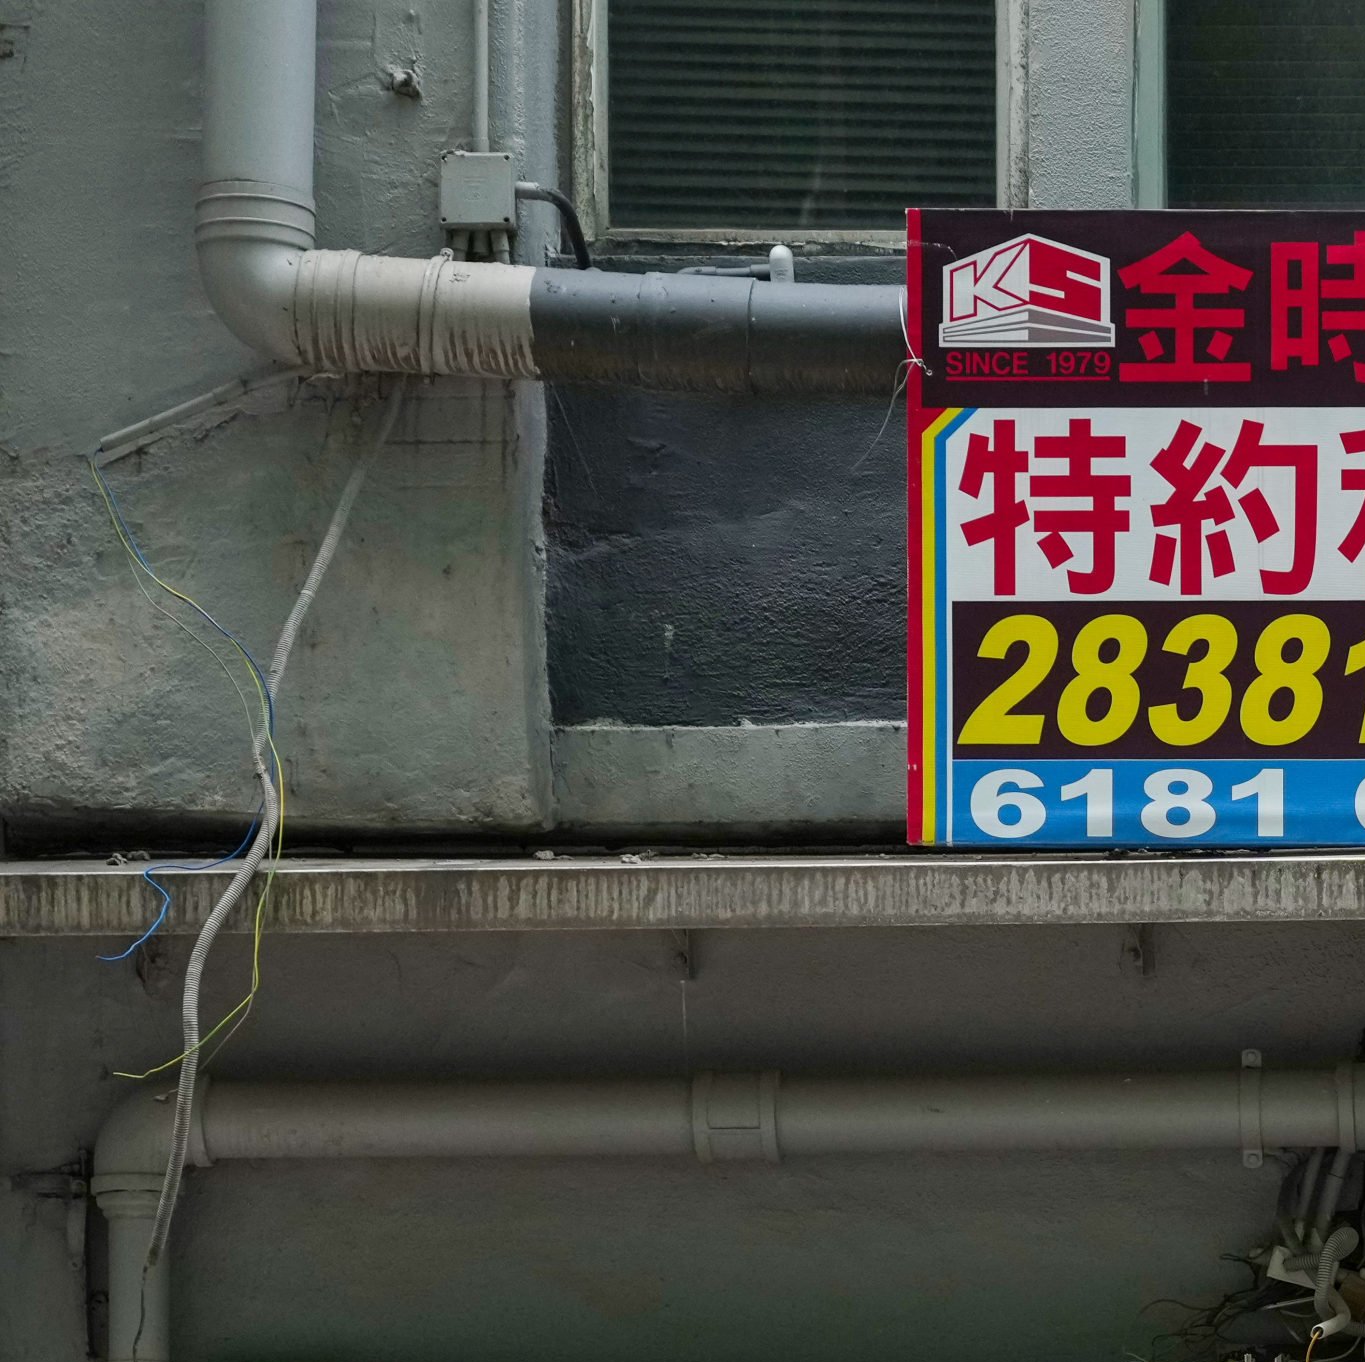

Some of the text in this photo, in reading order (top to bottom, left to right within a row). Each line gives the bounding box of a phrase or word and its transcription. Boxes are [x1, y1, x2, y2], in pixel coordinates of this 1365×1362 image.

[950, 236, 1108, 325] KS
[945, 352, 1111, 375] SINCE 1979
[970, 769, 1285, 838] 6181
